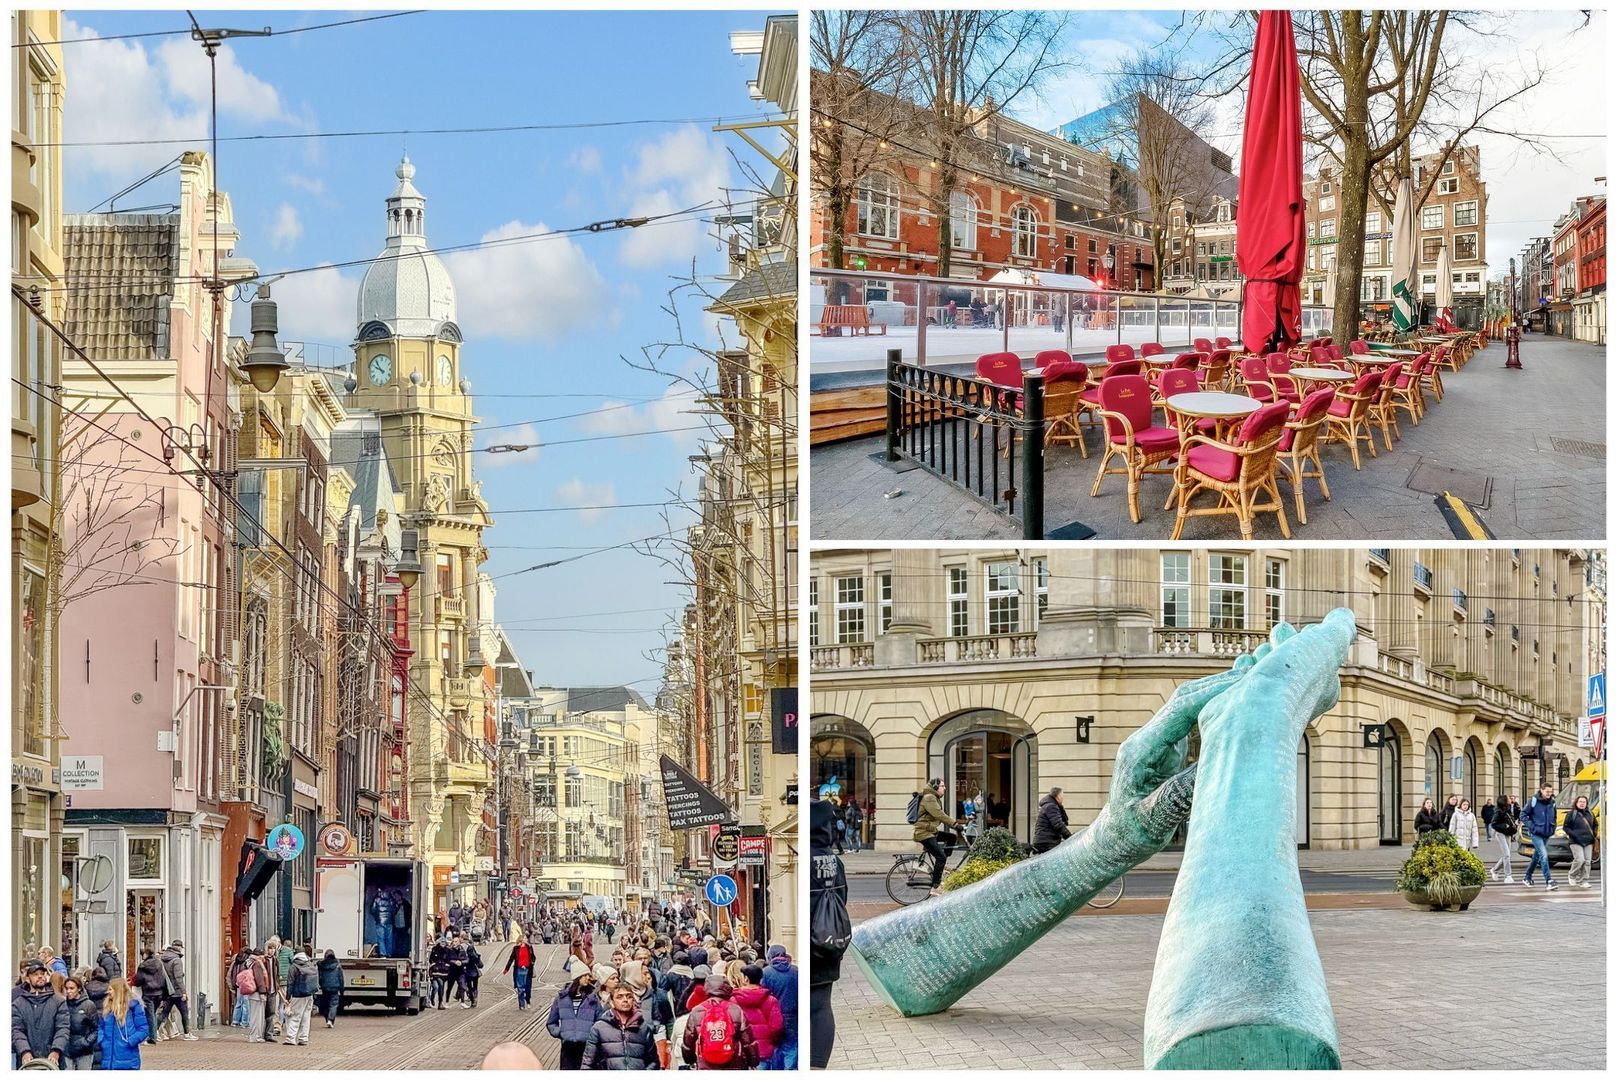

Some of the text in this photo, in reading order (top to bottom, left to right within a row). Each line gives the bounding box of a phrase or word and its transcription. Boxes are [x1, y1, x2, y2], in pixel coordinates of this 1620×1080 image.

[76, 760, 86, 770] M
[667, 792, 699, 802] TATTOOS
[668, 800, 701, 810] PIERCINGS
[669, 807, 702, 818] TATTOOS
[671, 812, 725, 827] PAX TATTOOS
[711, 1029, 724, 1041] 23
